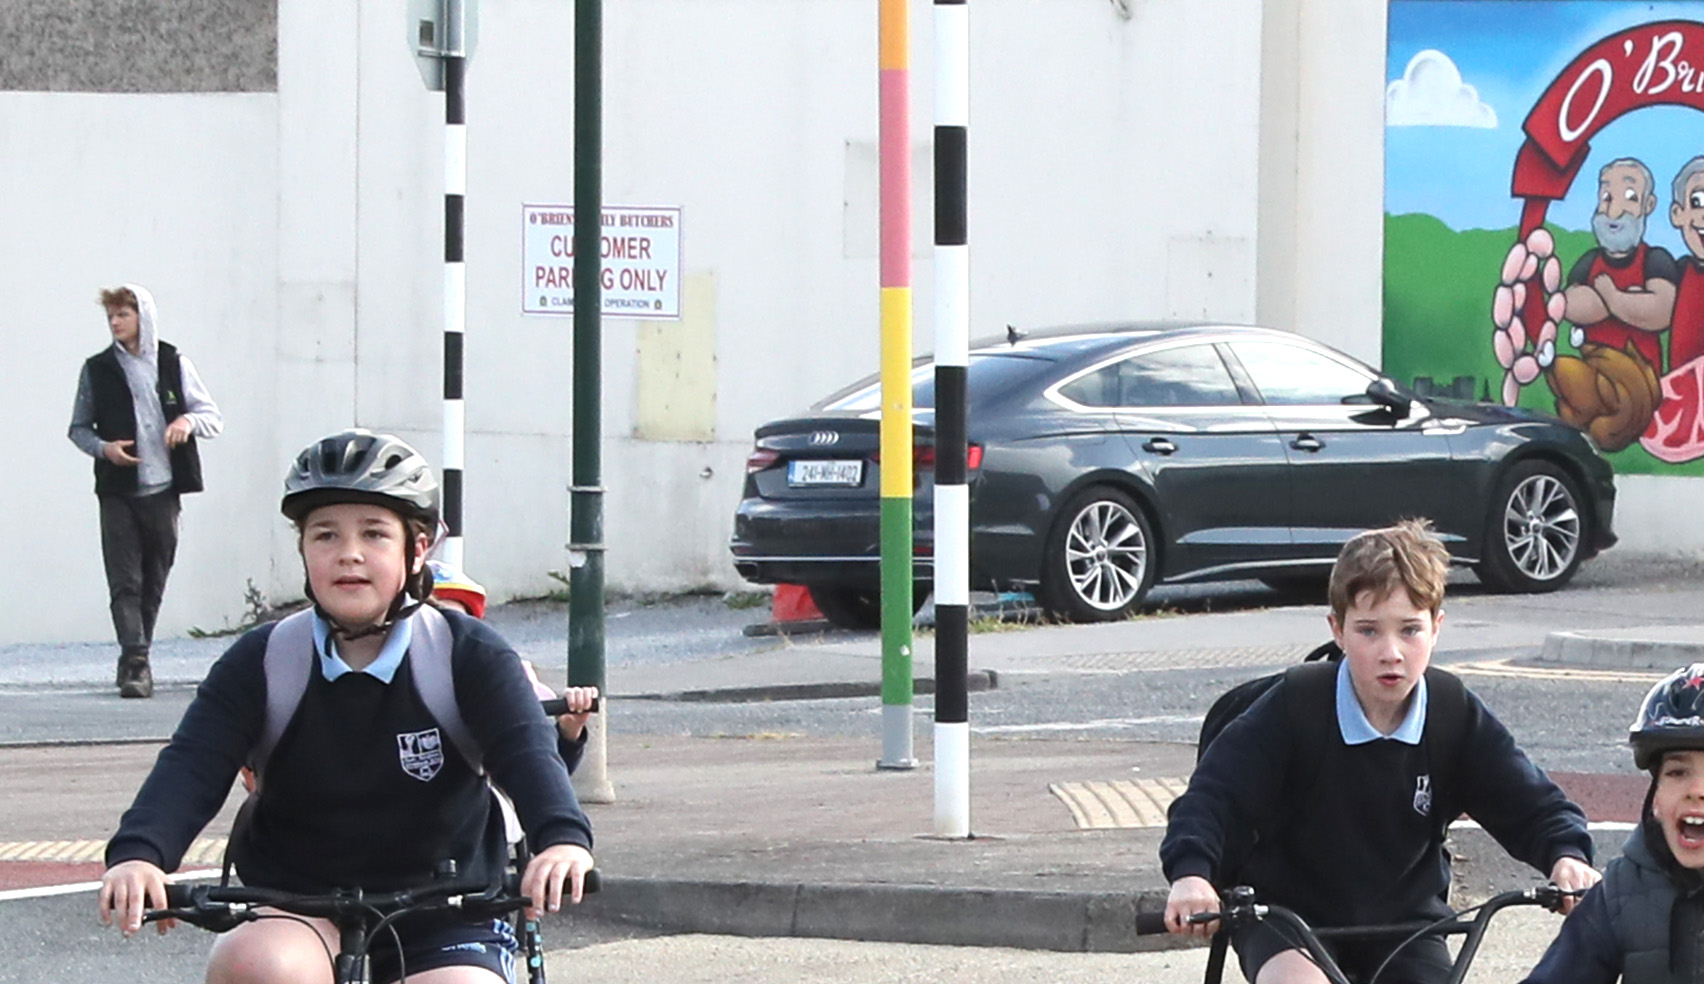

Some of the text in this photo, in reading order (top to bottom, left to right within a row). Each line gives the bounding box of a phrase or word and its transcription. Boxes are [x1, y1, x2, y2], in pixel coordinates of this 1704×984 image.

[530, 212, 575, 225] O'BRIEN
[619, 214, 674, 228] BUTCHERS
[551, 235, 652, 259] CUOMER
[535, 266, 668, 291] PARG ONLY
[604, 299, 650, 309] OPERATION
